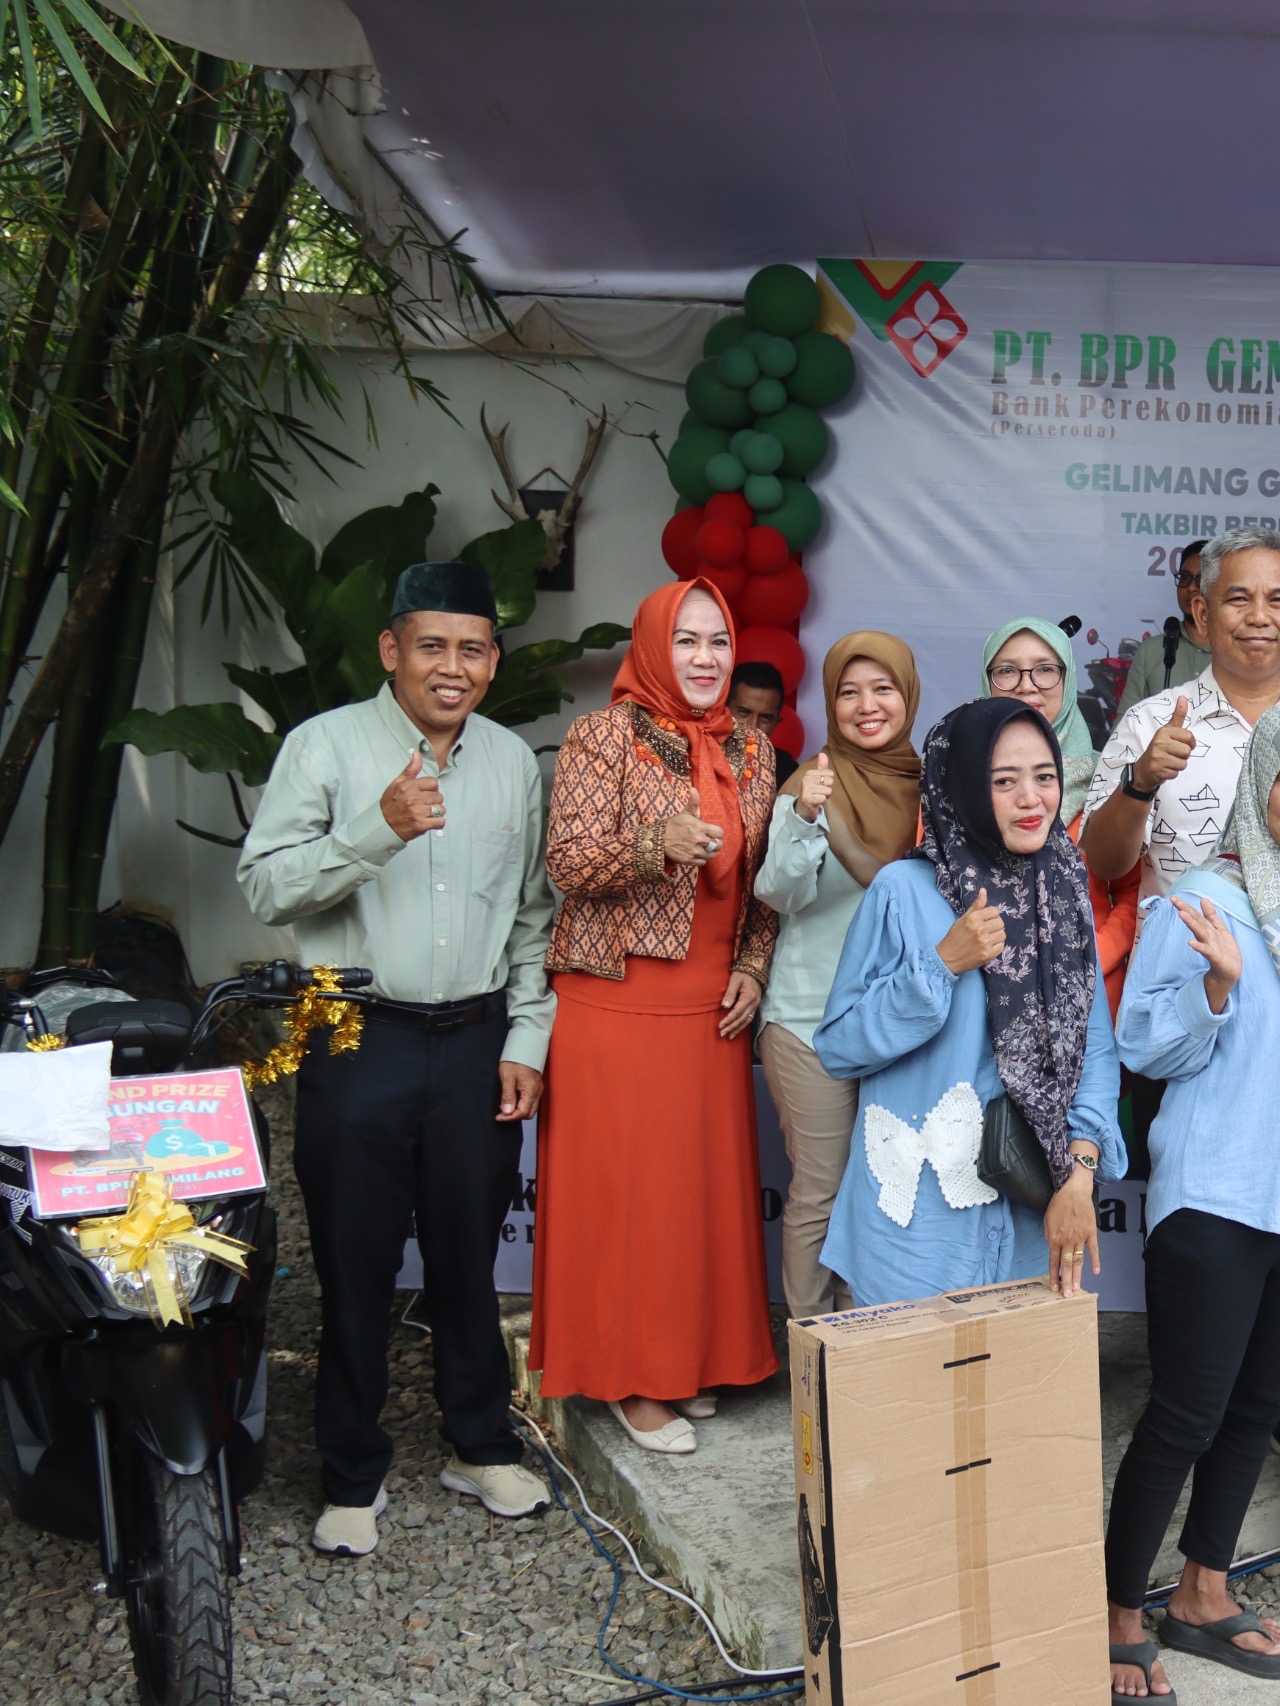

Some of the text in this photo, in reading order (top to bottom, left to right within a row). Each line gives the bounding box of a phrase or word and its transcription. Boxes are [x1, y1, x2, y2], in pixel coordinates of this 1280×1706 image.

[990, 330, 1062, 387] PT.
[1078, 332, 1177, 390] BPR
[991, 391, 1070, 417] Bank
[990, 420, 1116, 440] (Perseroda)
[1065, 462, 1249, 497] GELIMANG
[1121, 512, 1218, 537] TAKBIR
[152, 1084, 230, 1098] PRIZE
[61, 1185, 92, 1197] PT.
[166, 1167, 246, 1185] MILANG
[840, 1304, 916, 1320] Miyako
